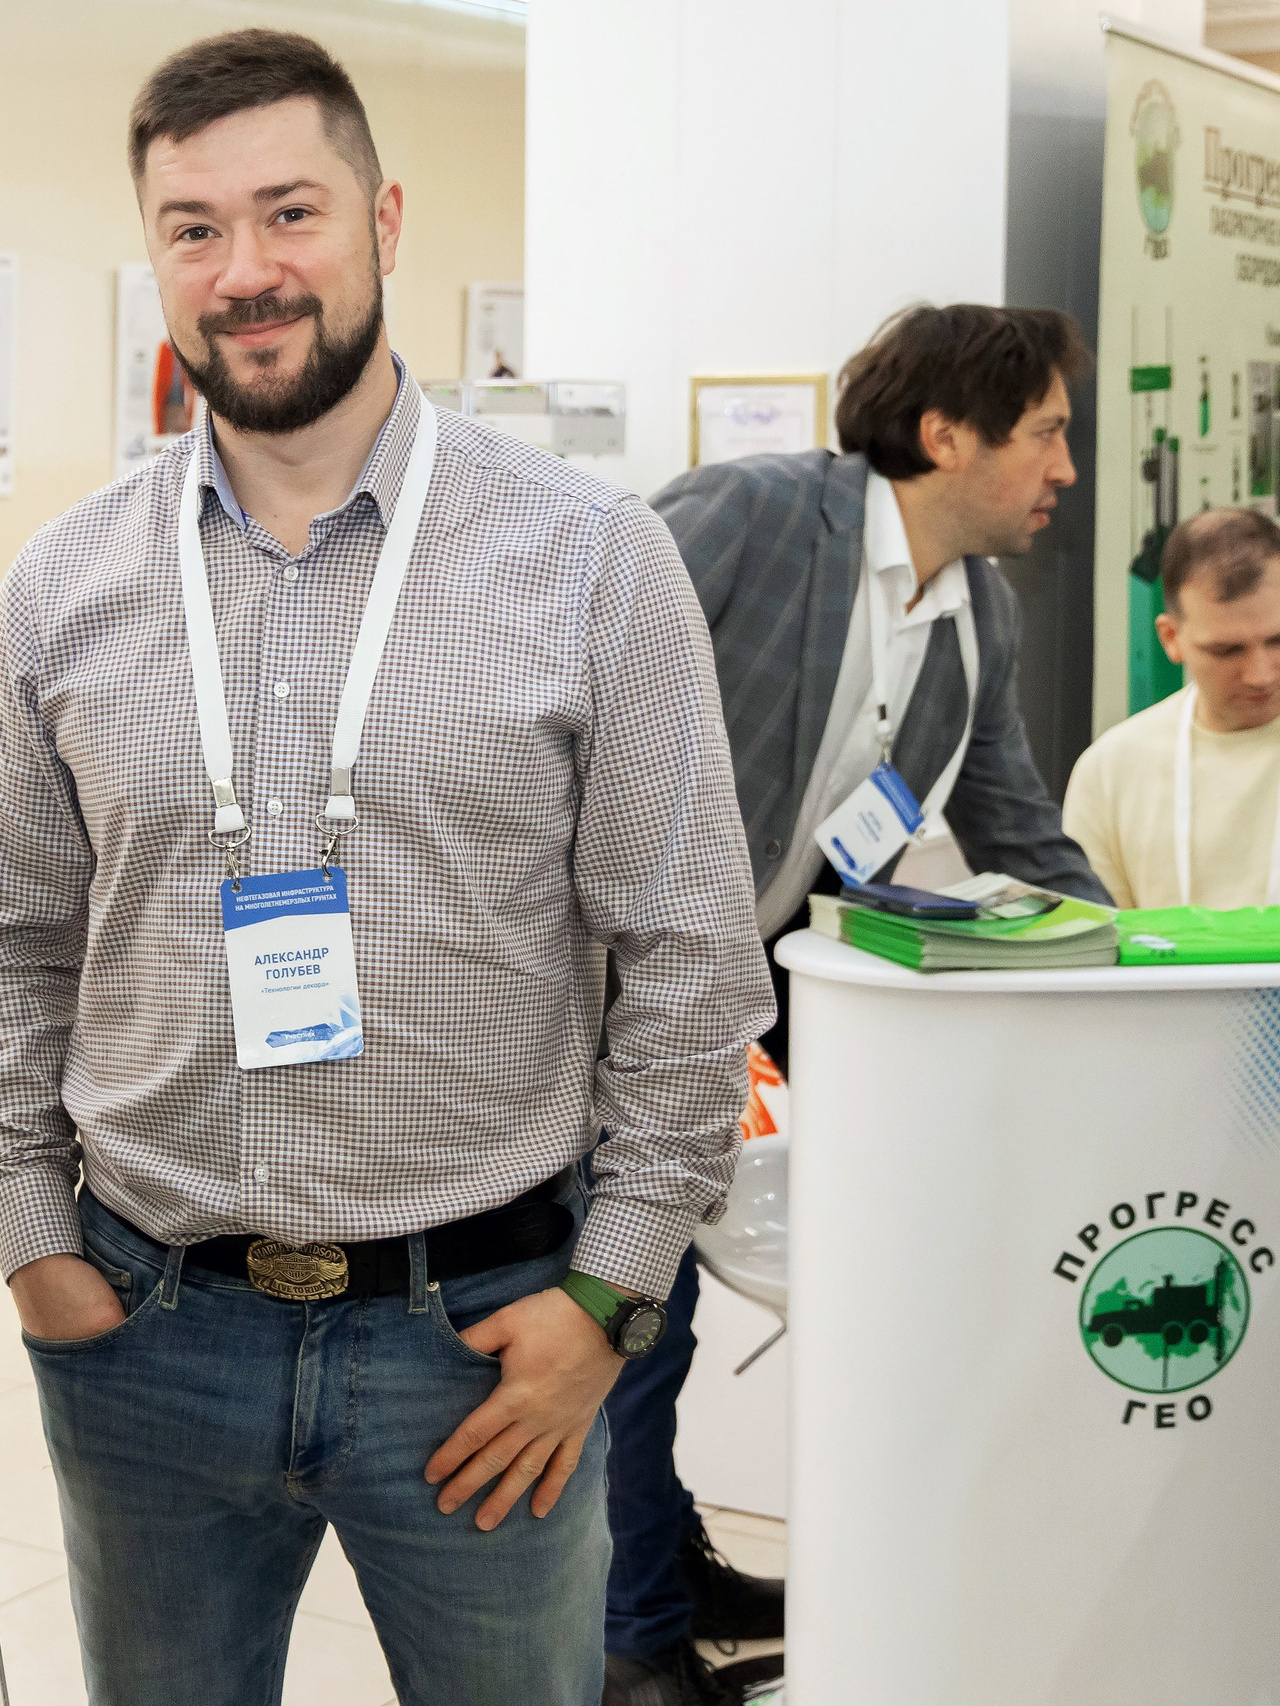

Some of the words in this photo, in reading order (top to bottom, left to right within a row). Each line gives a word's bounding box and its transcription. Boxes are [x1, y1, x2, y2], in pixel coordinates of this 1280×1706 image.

[236, 891, 281, 902] НЕФТЕГАЗОВАЯ
[281, 885, 335, 897] ИНФРАСТРУКТУРА
[245, 896, 311, 910] МНОГОЛЕТНЕМЕРЗЛЫХ
[311, 893, 337, 902] ГРУНТАХ
[254, 947, 329, 966] АЛЕКСАНДР
[266, 964, 321, 980] ГОЛУБЕВ
[261, 985, 301, 993] «Технологии
[303, 982, 329, 990] декора»
[1053, 1191, 1275, 1284] ПРОГРЕСС
[293, 1286, 304, 1294] TO
[305, 1284, 324, 1294] RIDE
[1121, 1394, 1213, 1429] ГЕО
